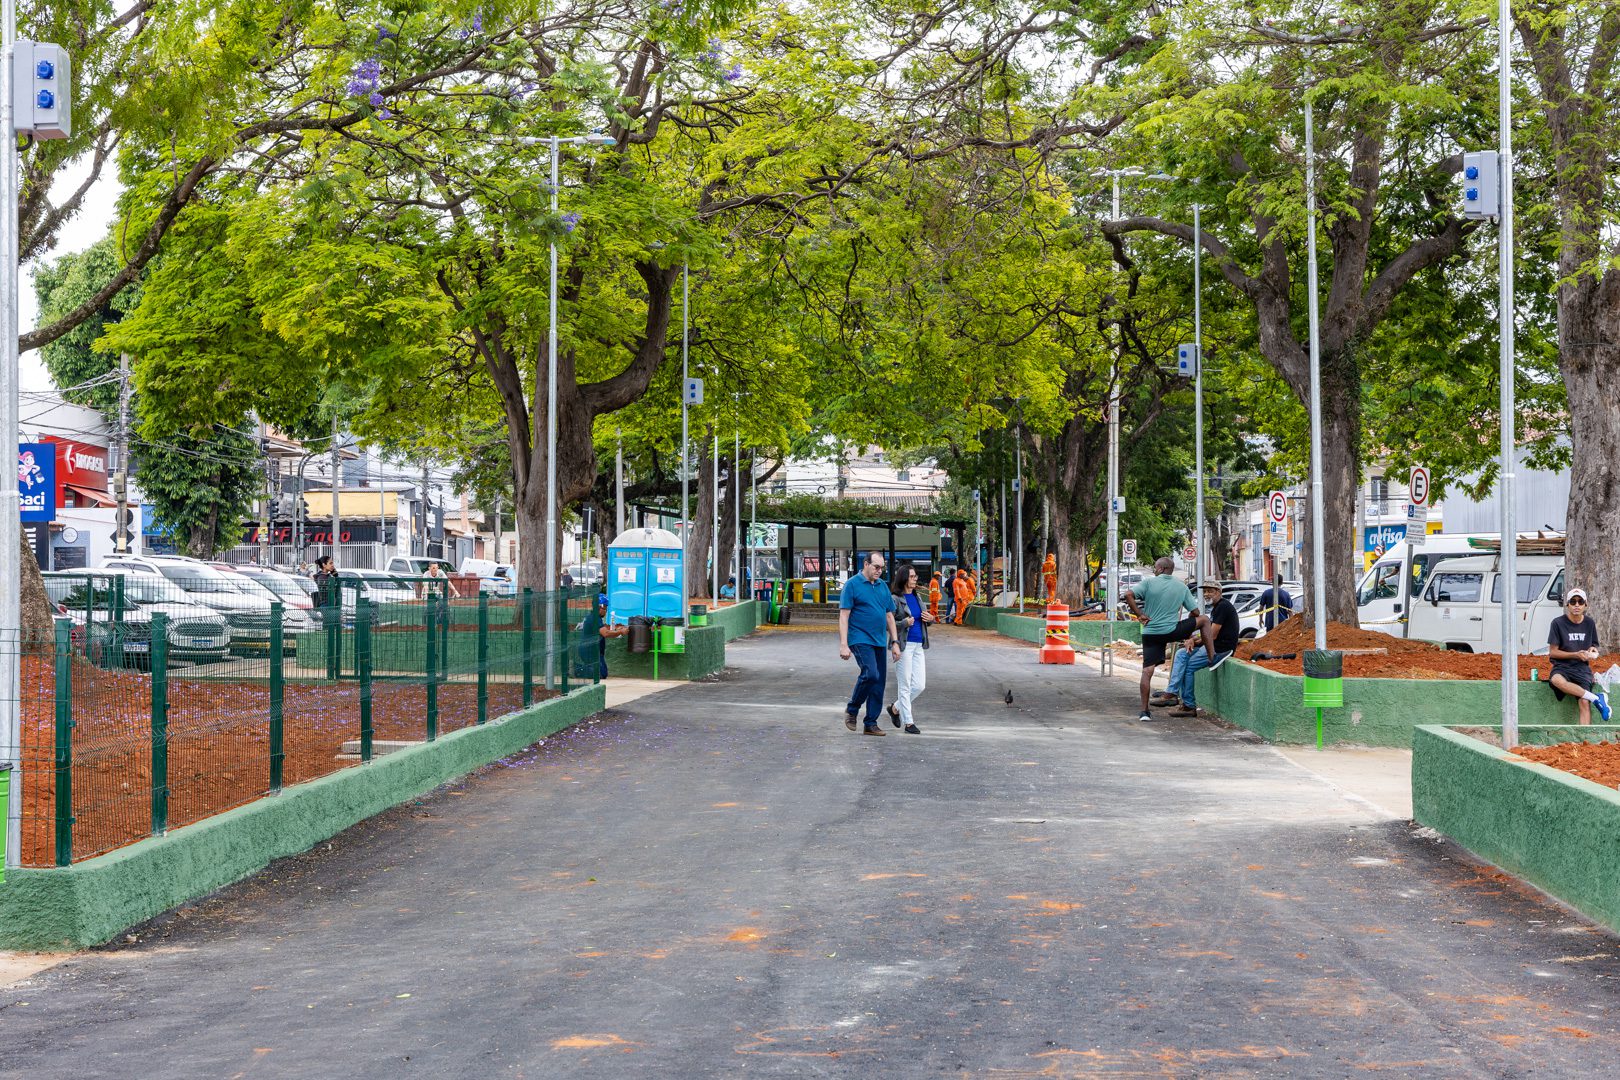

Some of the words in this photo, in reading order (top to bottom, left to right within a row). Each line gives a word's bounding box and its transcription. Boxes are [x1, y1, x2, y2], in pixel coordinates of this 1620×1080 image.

[1414, 476, 1423, 497] E
[1275, 498, 1282, 516] E
[1568, 633, 1586, 641] NEW
